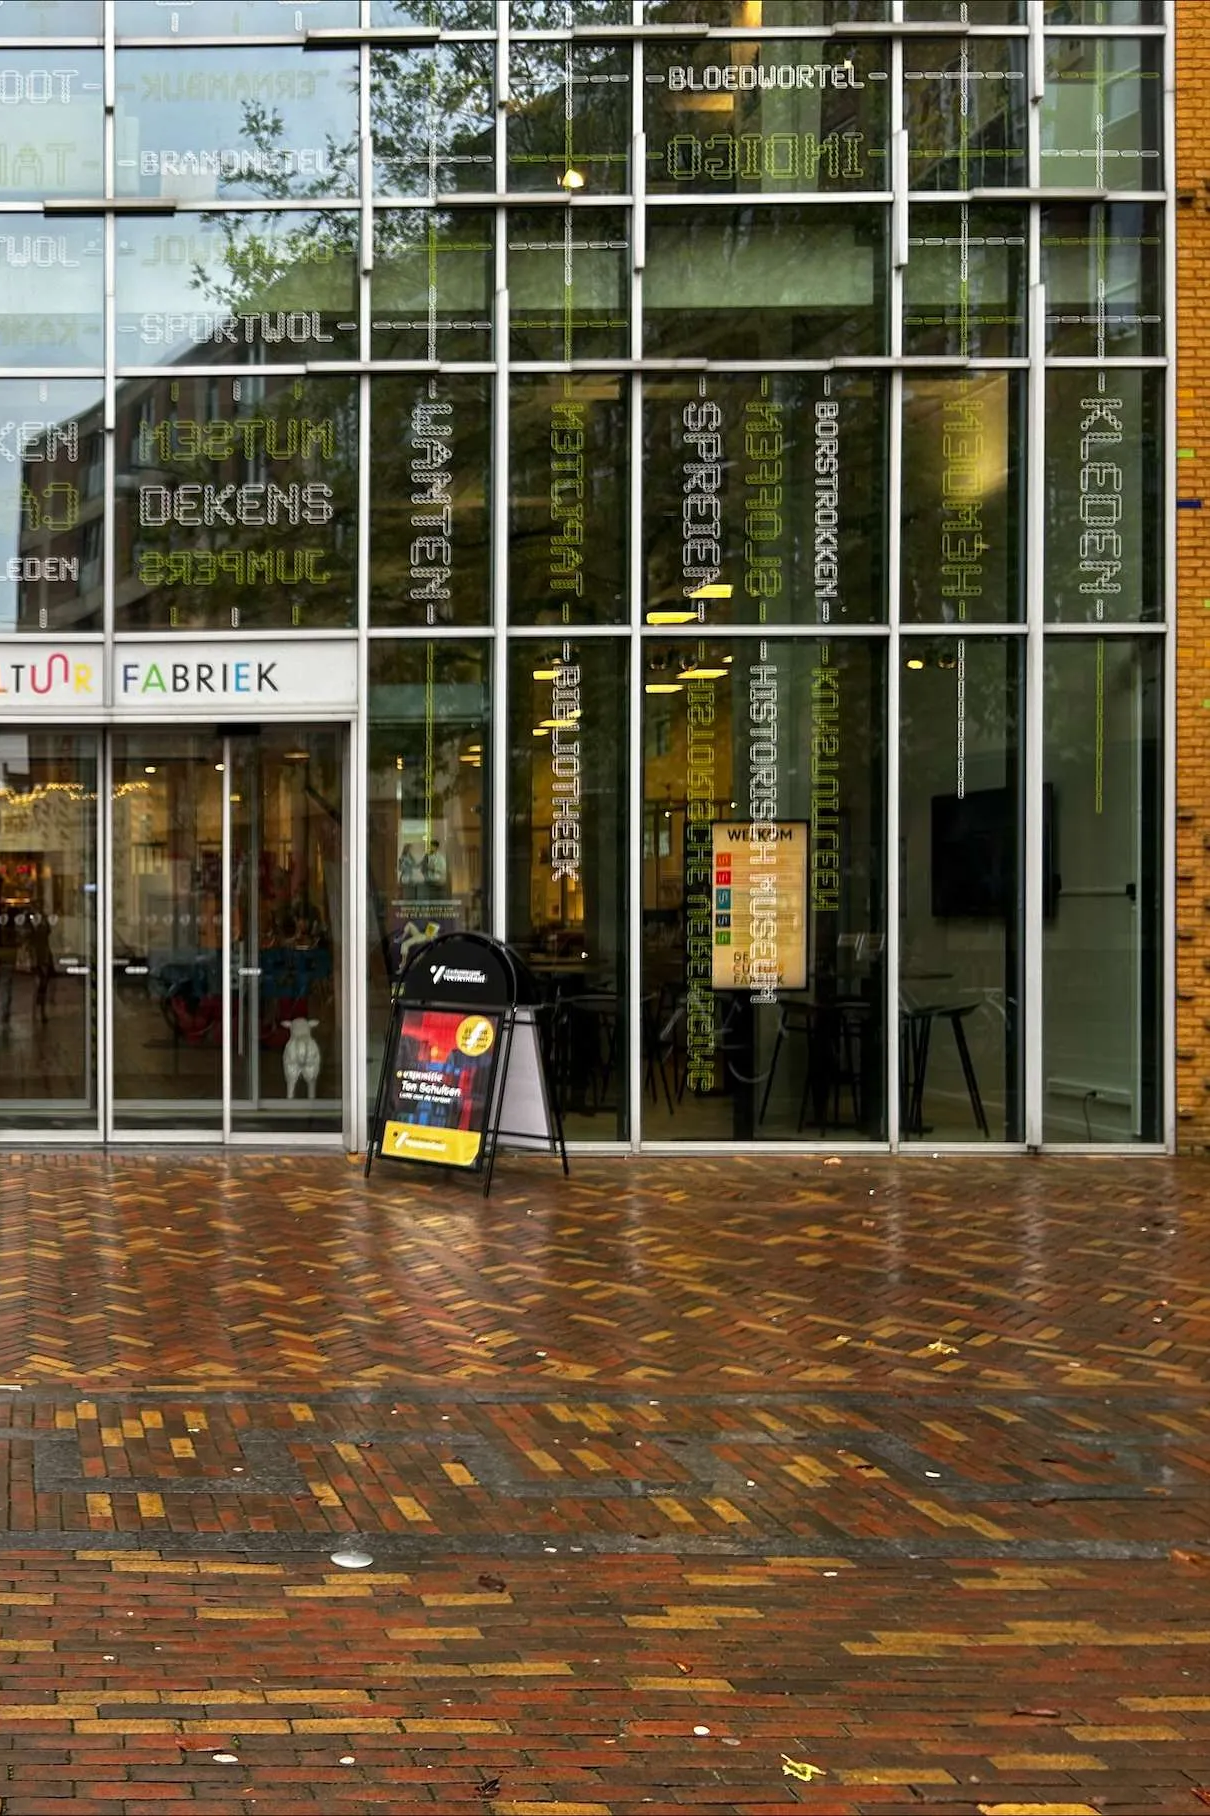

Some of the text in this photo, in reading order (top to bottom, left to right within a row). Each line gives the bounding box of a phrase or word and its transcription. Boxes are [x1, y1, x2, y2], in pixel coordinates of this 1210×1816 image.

[668, 64, 865, 91] BLOEDWORTEL
[140, 149, 335, 176] BRANDNETEL
[140, 312, 334, 344] SPORTWOL
[139, 484, 333, 527] DEKENS
[411, 403, 453, 599] WANTEN
[683, 401, 721, 597] SPREIEN
[815, 401, 838, 598] BORSTROKKEN
[1080, 398, 1122, 594] KLEDEN
[122, 662, 279, 692] FABRIEK
[552, 665, 581, 881] BIBLIOTHEEK
[749, 665, 777, 864] HISTORISCH
[749, 873, 777, 1003] MUSEUM
